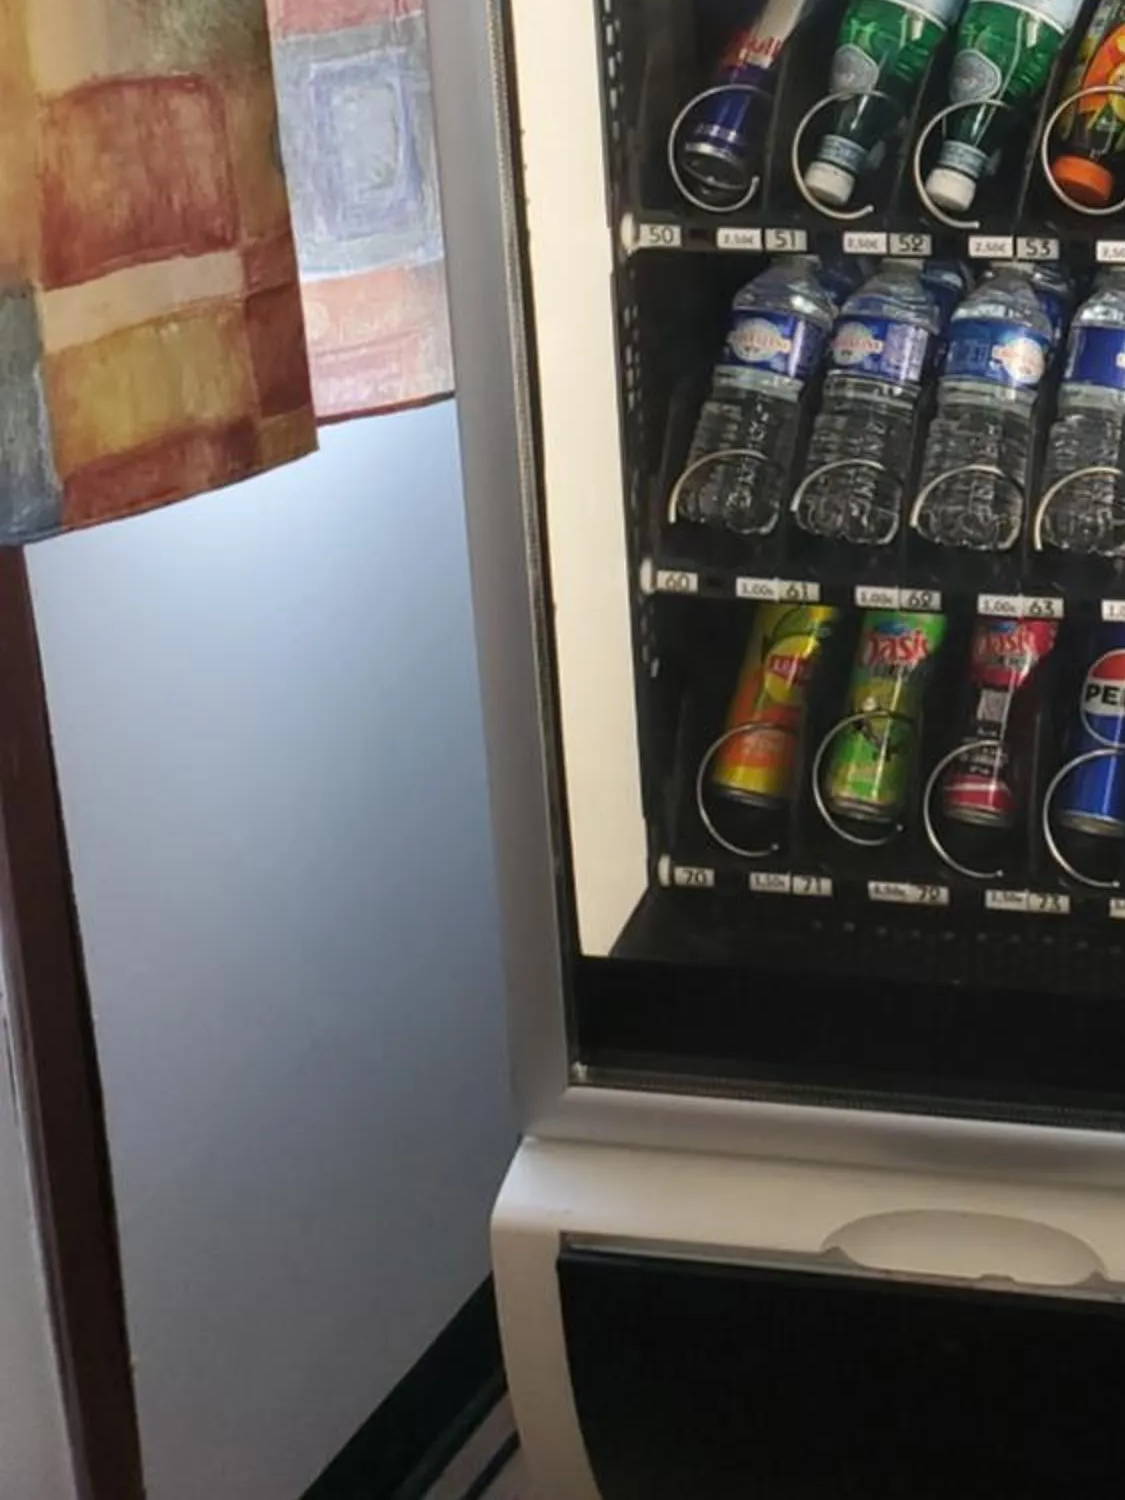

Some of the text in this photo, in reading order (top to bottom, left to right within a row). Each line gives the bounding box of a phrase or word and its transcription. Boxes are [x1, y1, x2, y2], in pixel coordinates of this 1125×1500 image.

[648, 227, 674, 244] 50
[774, 231, 797, 249] 51
[898, 234, 923, 253] 52
[1025, 239, 1051, 257] 53
[665, 573, 689, 592] 60
[786, 581, 807, 599] 61
[1029, 598, 1055, 617] 63
[682, 869, 707, 885] 70
